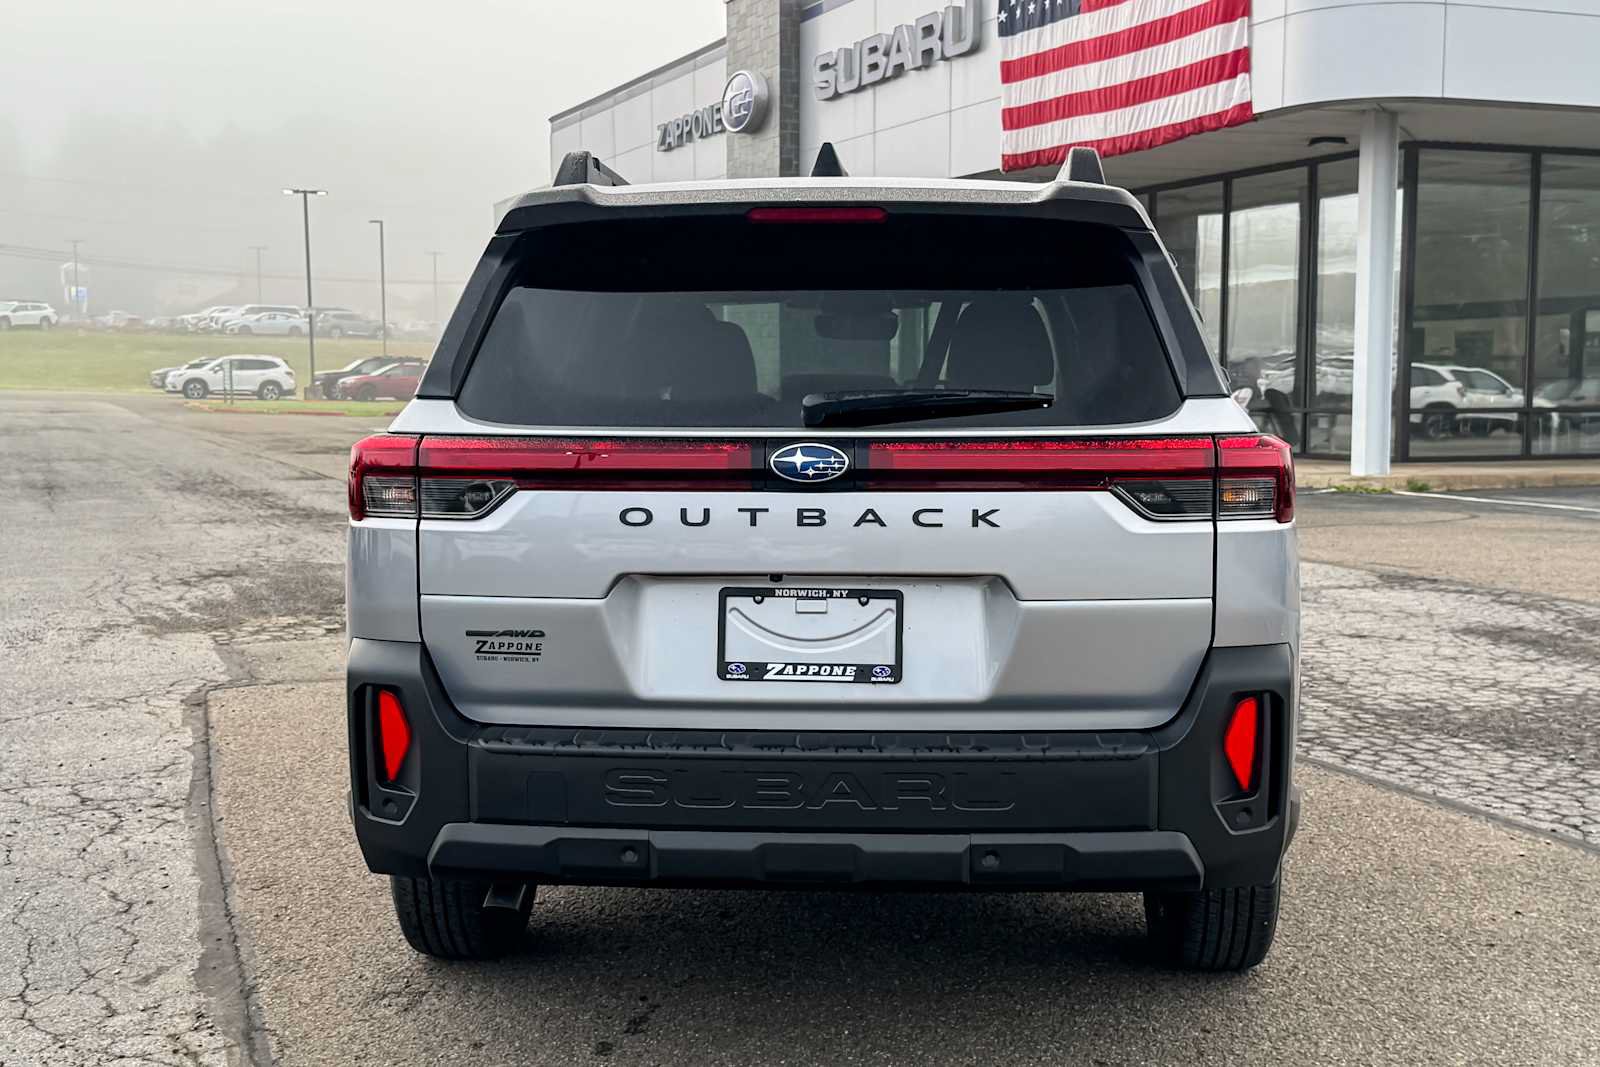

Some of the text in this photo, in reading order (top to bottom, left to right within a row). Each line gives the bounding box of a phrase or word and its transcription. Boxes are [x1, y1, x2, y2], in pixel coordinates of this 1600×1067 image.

[814, 0, 981, 101] SUBARU
[657, 101, 723, 152] ZAPPONE
[618, 507, 1001, 528] OUTBACK
[832, 589, 849, 598] NY
[474, 640, 543, 654] ZAPPONE
[762, 663, 857, 681] ZAPPONE
[604, 767, 1017, 811] SUBARU
